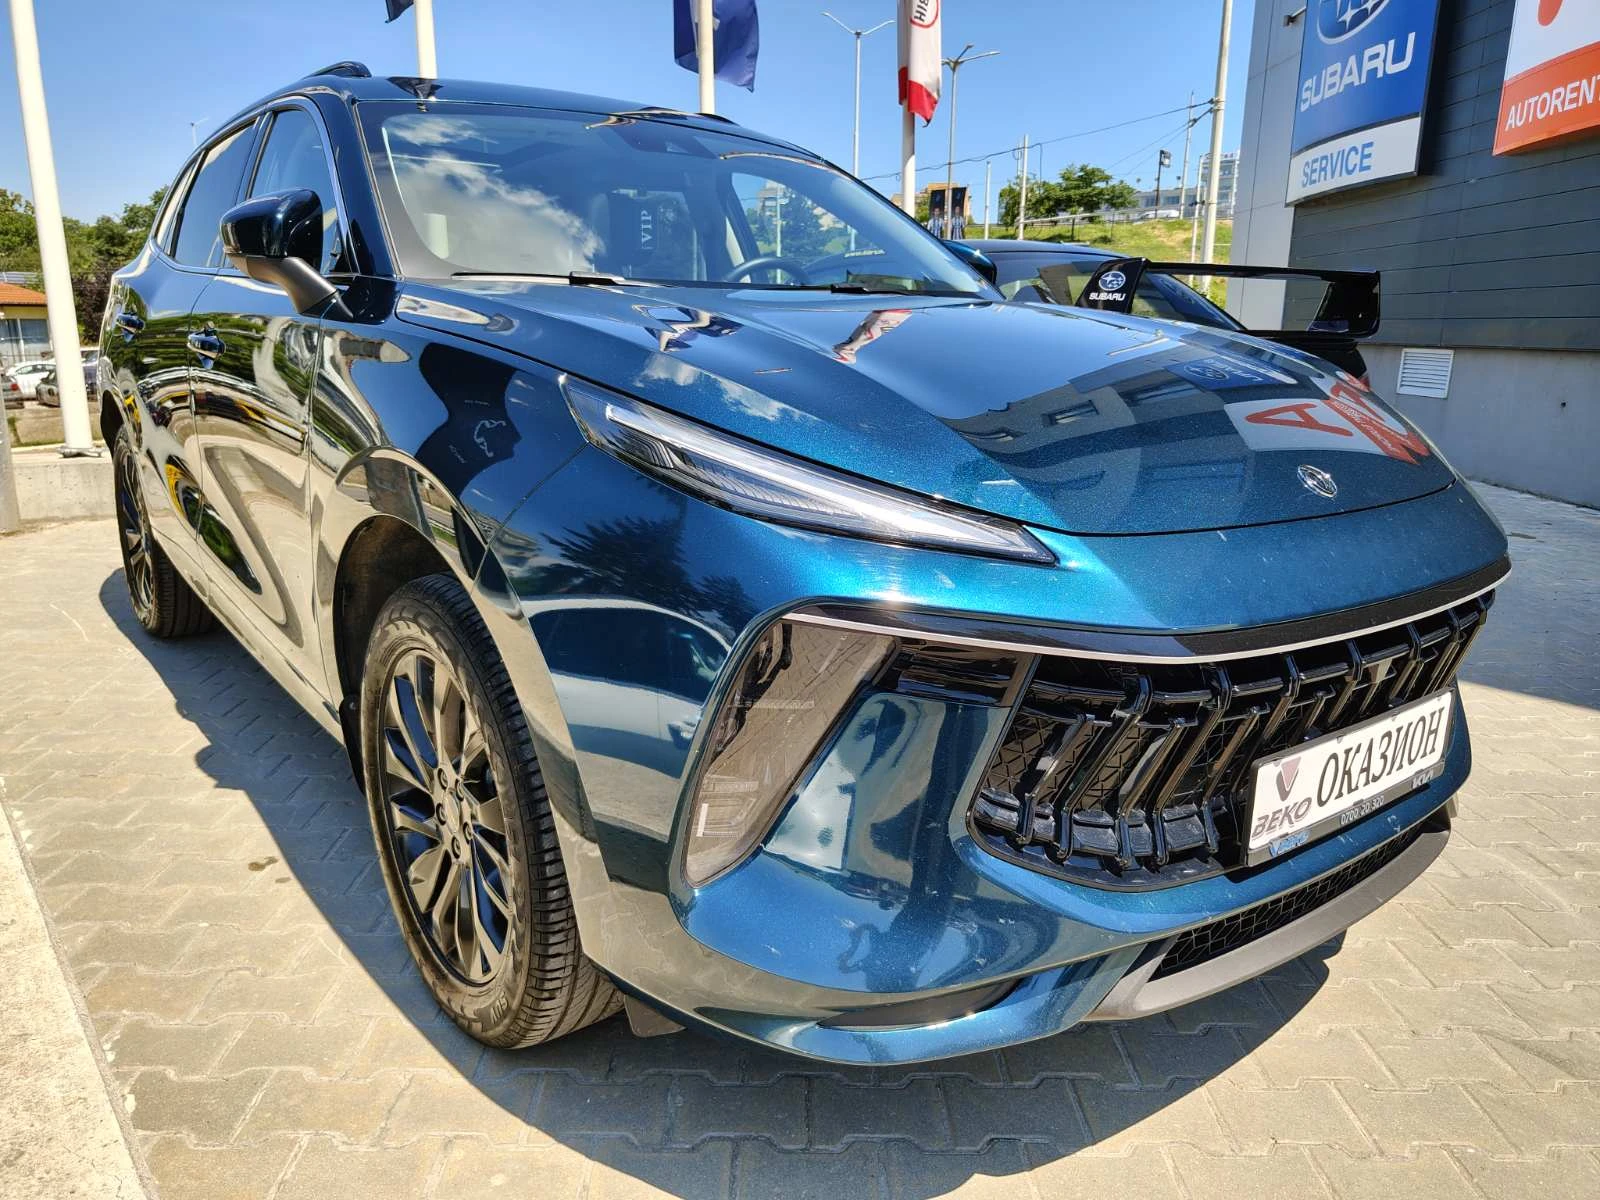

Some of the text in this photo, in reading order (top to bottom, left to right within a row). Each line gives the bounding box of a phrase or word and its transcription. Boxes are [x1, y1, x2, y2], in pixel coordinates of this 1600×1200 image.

[1300, 31, 1417, 113] SUBARU
[1504, 73, 1600, 132] AUTOREN
[1302, 141, 1375, 189] SERVICE
[1089, 292, 1126, 301] SUBARU
[1316, 706, 1445, 807] ОКАЗИОН
